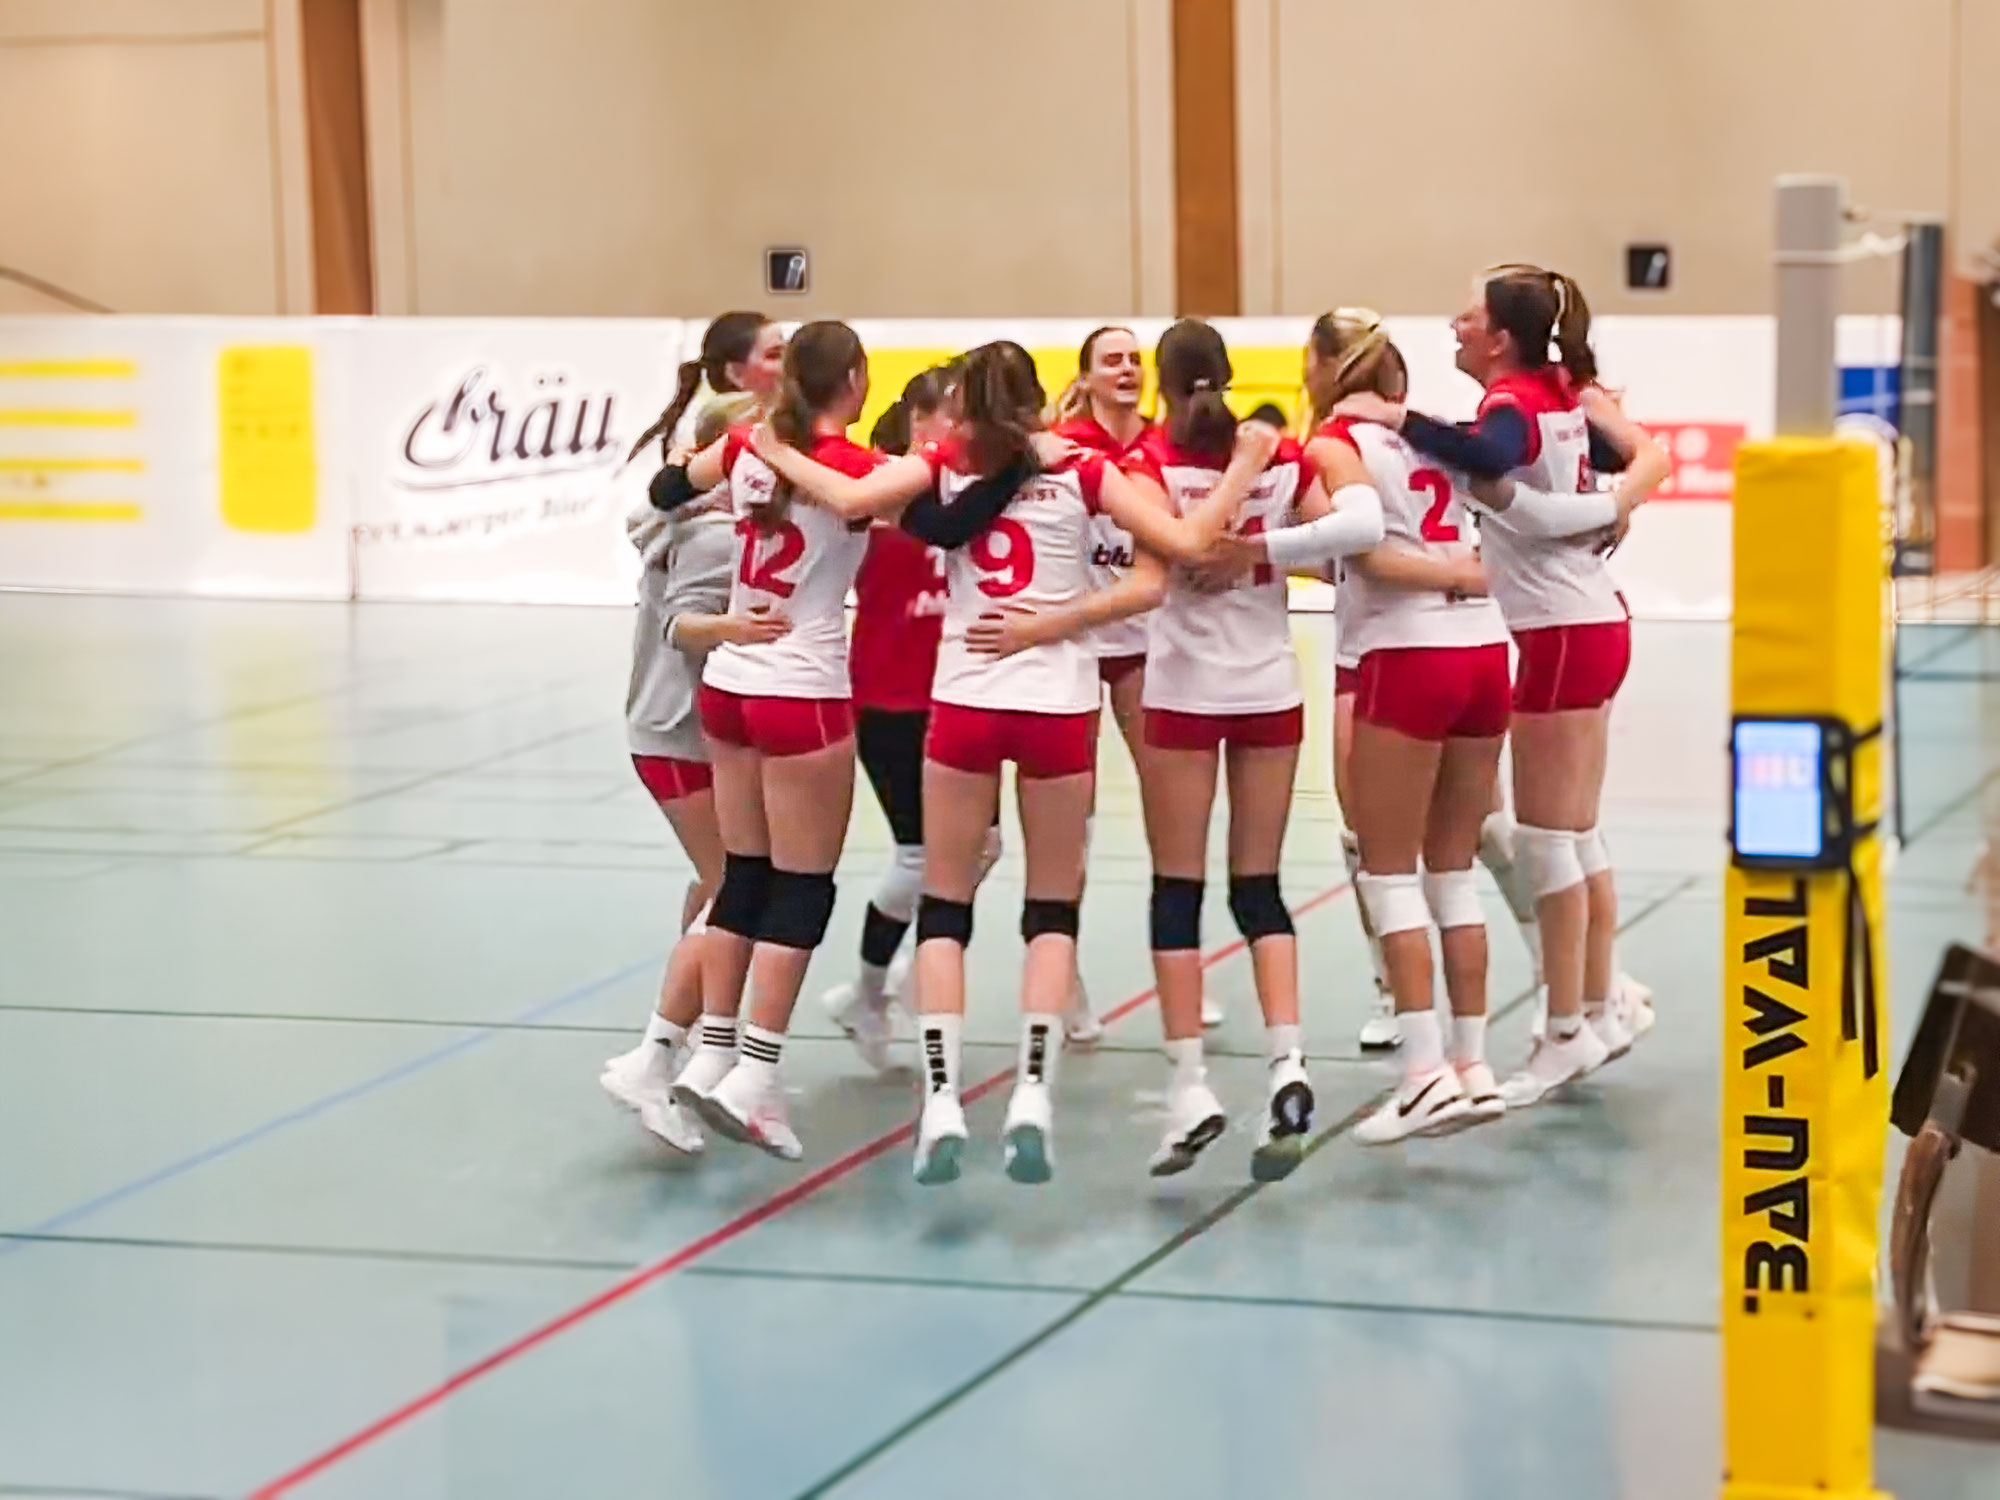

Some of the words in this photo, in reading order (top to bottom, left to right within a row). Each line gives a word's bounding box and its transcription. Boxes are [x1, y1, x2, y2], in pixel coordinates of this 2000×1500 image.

[1408, 468, 1459, 542] 2
[735, 517, 806, 599] 12
[970, 516, 1034, 598] 9
